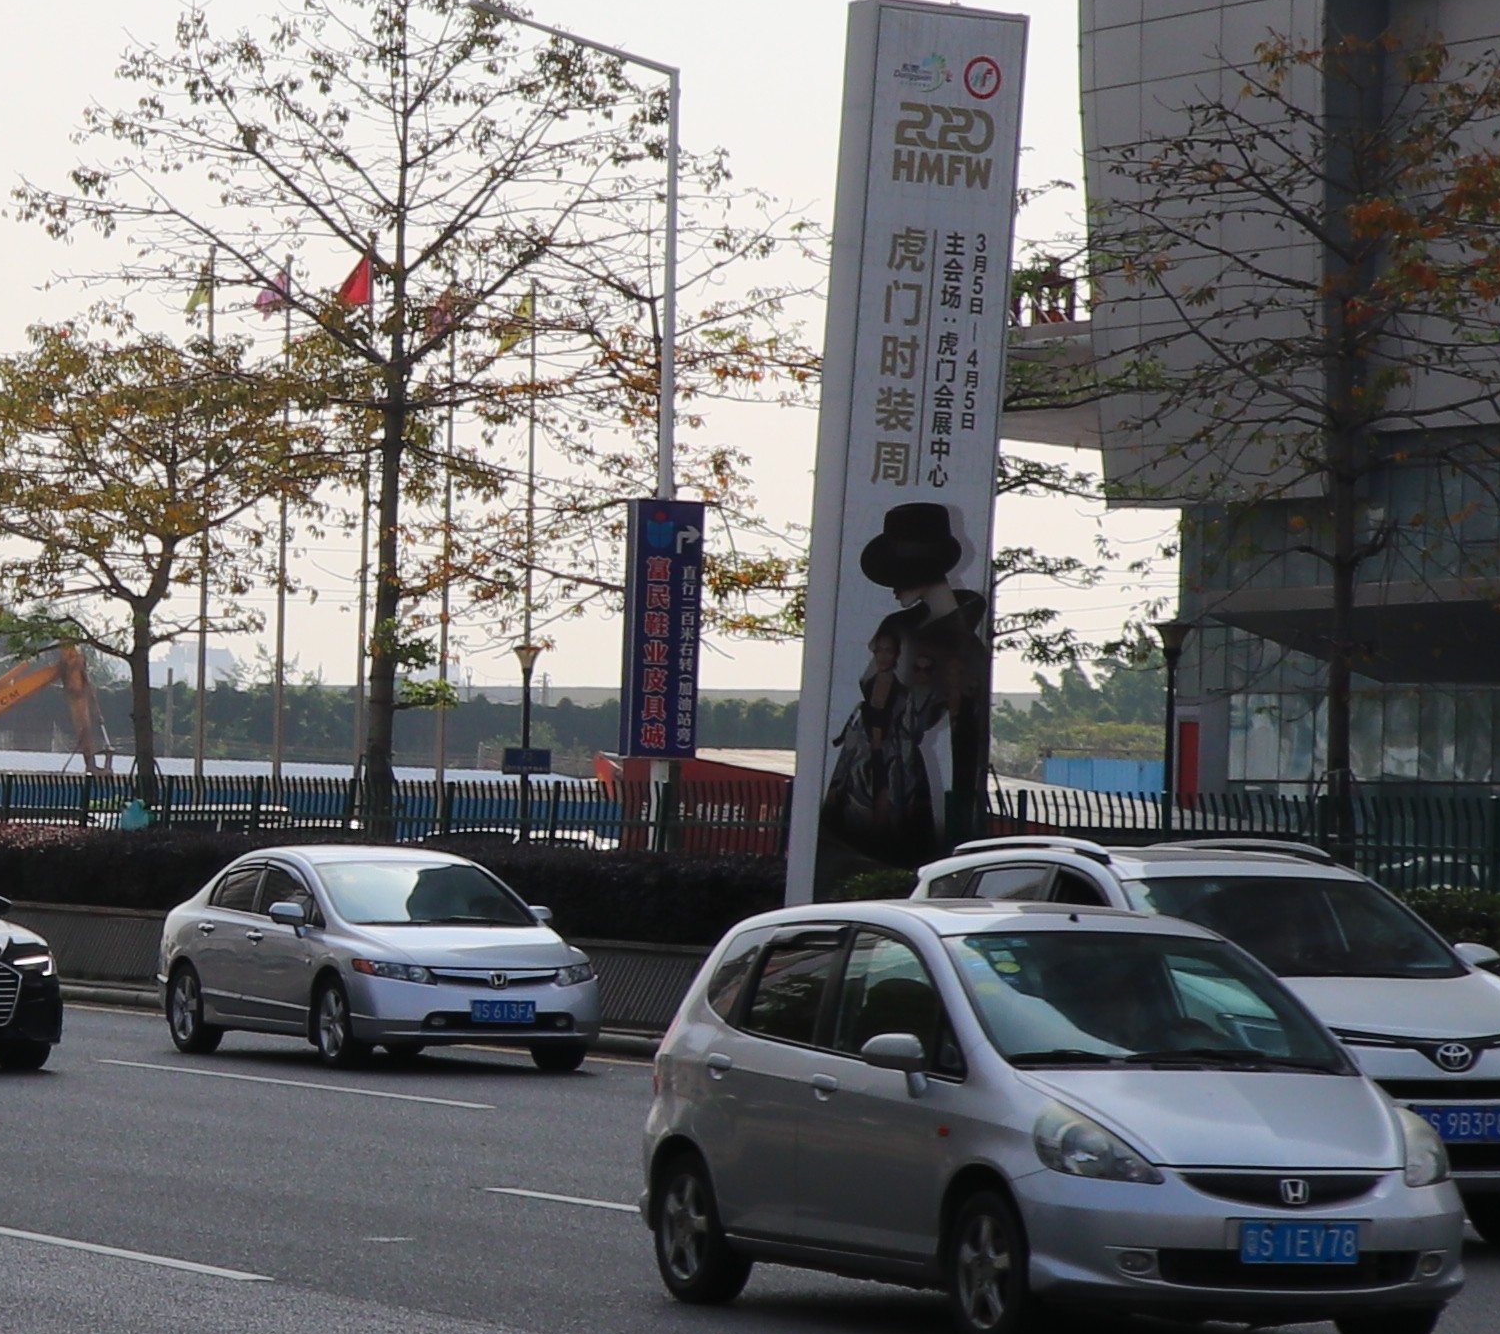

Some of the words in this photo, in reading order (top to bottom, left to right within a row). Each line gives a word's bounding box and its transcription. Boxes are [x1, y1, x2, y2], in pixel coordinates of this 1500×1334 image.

[892, 148, 992, 190] HMFW
[870, 226, 927, 487] 虎门时装周
[640, 556, 673, 748] 富民鞋业皮具城
